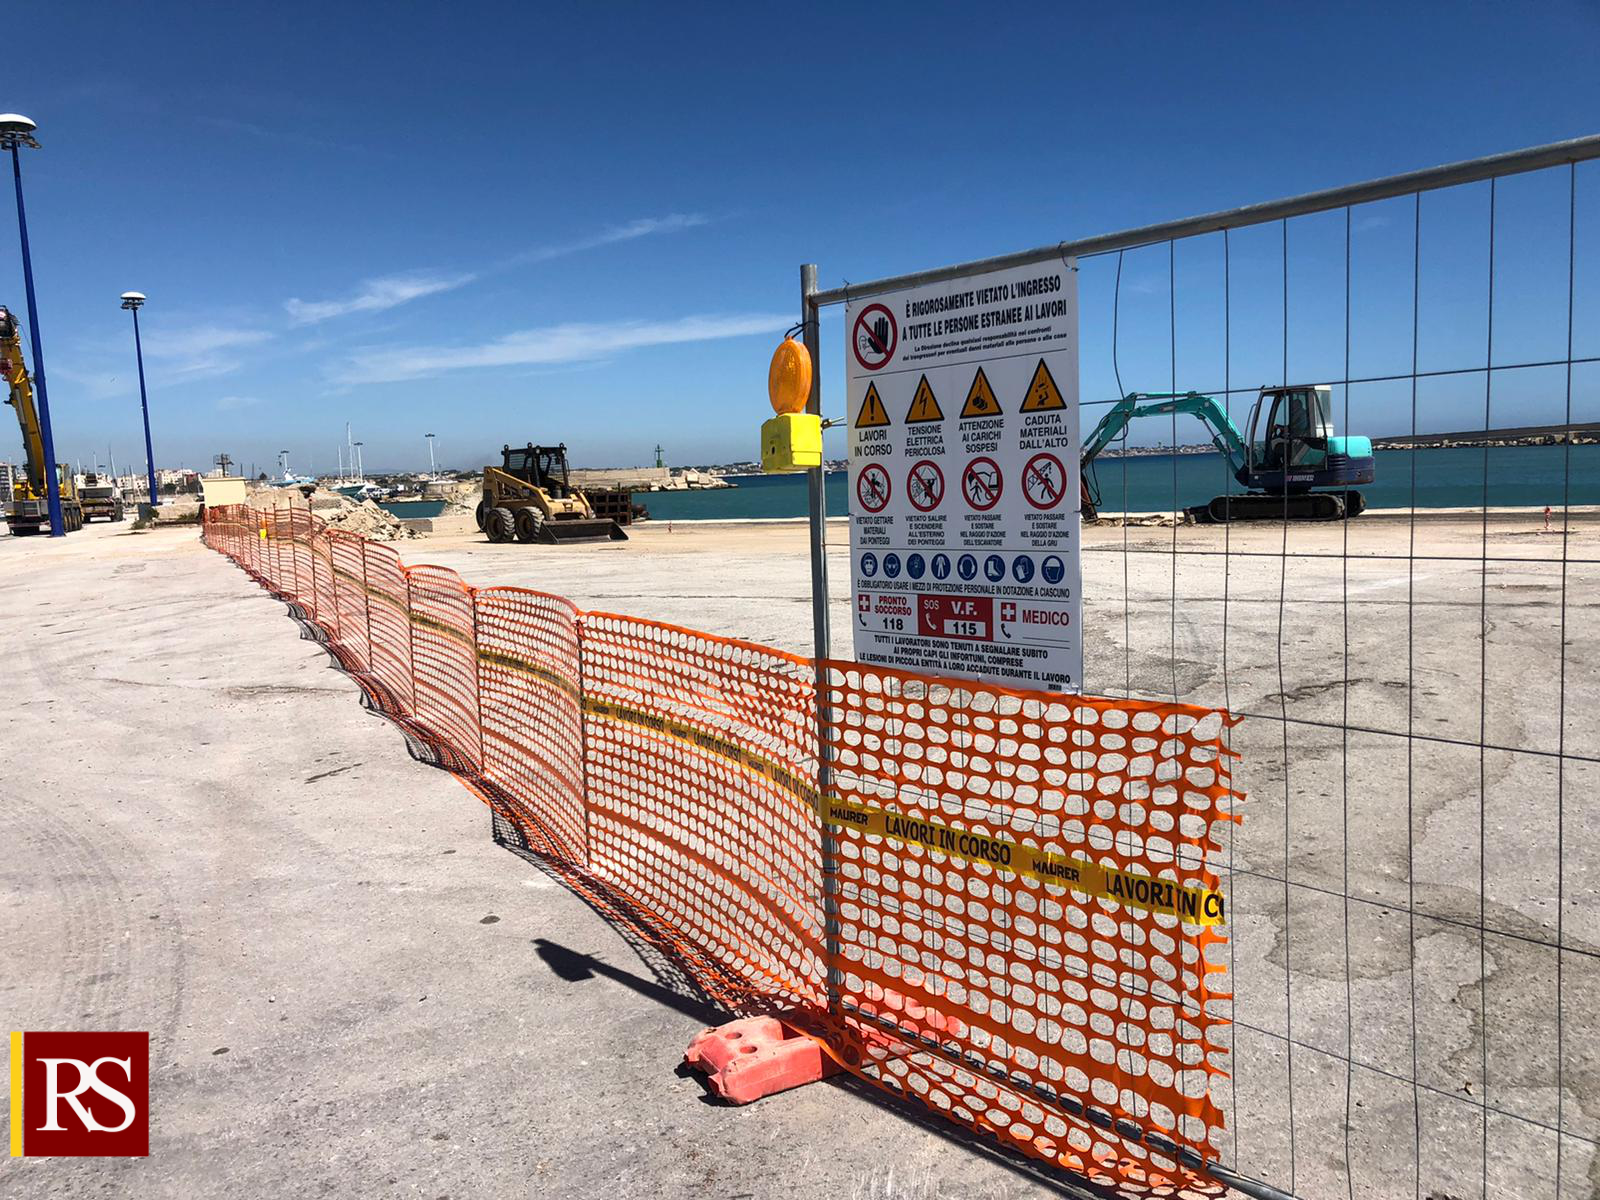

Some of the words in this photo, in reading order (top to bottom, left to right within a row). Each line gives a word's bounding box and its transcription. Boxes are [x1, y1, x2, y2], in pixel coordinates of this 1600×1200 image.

[906, 300, 910, 318] È
[912, 292, 974, 316] RIGOROSAMENTE
[976, 285, 1008, 305] VIETATO
[1011, 275, 1061, 299] L'INGRESSO
[902, 327, 907, 341] A
[909, 323, 932, 340] TUTTE
[934, 321, 942, 336] LE
[945, 315, 979, 334] PERSONE
[981, 308, 1022, 328] ESTRANEE
[1025, 305, 1032, 320] AI
[1036, 299, 1067, 320] LAVORI
[959, 419, 1004, 431] ATTENZIONE
[1025, 414, 1061, 425] CADUTA
[859, 429, 887, 442] LAVORI
[908, 425, 941, 436] TENSIONE
[962, 434, 969, 442] AI
[971, 431, 1001, 441] CARICHI
[1020, 426, 1067, 438] MATERIALI
[907, 436, 943, 446] ELETTRICA
[1019, 438, 1068, 450] DALL'ALTO
[855, 447, 862, 457] IN
[864, 444, 892, 456] CORSO
[905, 446, 945, 457] PERICOLOSA
[966, 442, 998, 453] SOSPESI
[874, 516, 893, 524] GETTARE
[868, 537, 890, 545] PONTEGGI
[861, 581, 893, 589] OBBLIGATORIO
[893, 582, 909, 590] USARE
[912, 583, 925, 591] MEZZI
[926, 584, 932, 592] DI
[932, 584, 963, 593] PROTEZIONE
[964, 585, 995, 594] PERSONALE
[1003, 587, 1033, 596] DOTAZIONE
[1035, 588, 1039, 596] A
[1040, 589, 1070, 598] CIASCUNO
[879, 596, 907, 606] PRONTO
[923, 600, 939, 610] SOS
[875, 604, 911, 615] SOCCORSO
[951, 601, 978, 616] V.F.
[1022, 609, 1069, 626] MEDICO
[882, 618, 904, 630] 118
[953, 622, 976, 635] 115
[874, 635, 889, 644] TUTTI
[895, 637, 931, 648] LAVORATORI
[932, 640, 949, 649] SONO
[951, 641, 973, 652] TENUTI
[975, 644, 980, 652] A
[981, 644, 1021, 656] SEGNALARE
[1022, 647, 1048, 659] SUBITO
[894, 646, 899, 654] AI
[901, 647, 922, 657] PROPRI
[923, 649, 937, 658] CAPI
[938, 651, 949, 659] GLI
[950, 651, 986, 663] INFORTUNI,
[987, 655, 1023, 667] COMPRESE
[860, 653, 866, 661] LE
[867, 653, 887, 662] LESIONI
[888, 656, 894, 664] DI
[895, 657, 920, 666] PICCOLA
[921, 658, 942, 668] ENTITÀ
[943, 661, 947, 669] A
[949, 662, 965, 671] LORO
[967, 664, 1000, 675] ACCADUTE
[1002, 667, 1032, 679] DURANTE
[1034, 671, 1040, 679] IL
[1042, 672, 1070, 684] LAVORO
[829, 807, 868, 826] MAURER
[885, 815, 936, 847] LAVORI
[939, 828, 955, 851] IN
[958, 835, 1011, 865] CORSO
[1032, 858, 1080, 883] MAURER
[1106, 872, 1174, 907] LAVORI
[1176, 888, 1196, 916] IN
[1204, 893, 1225, 918] C
